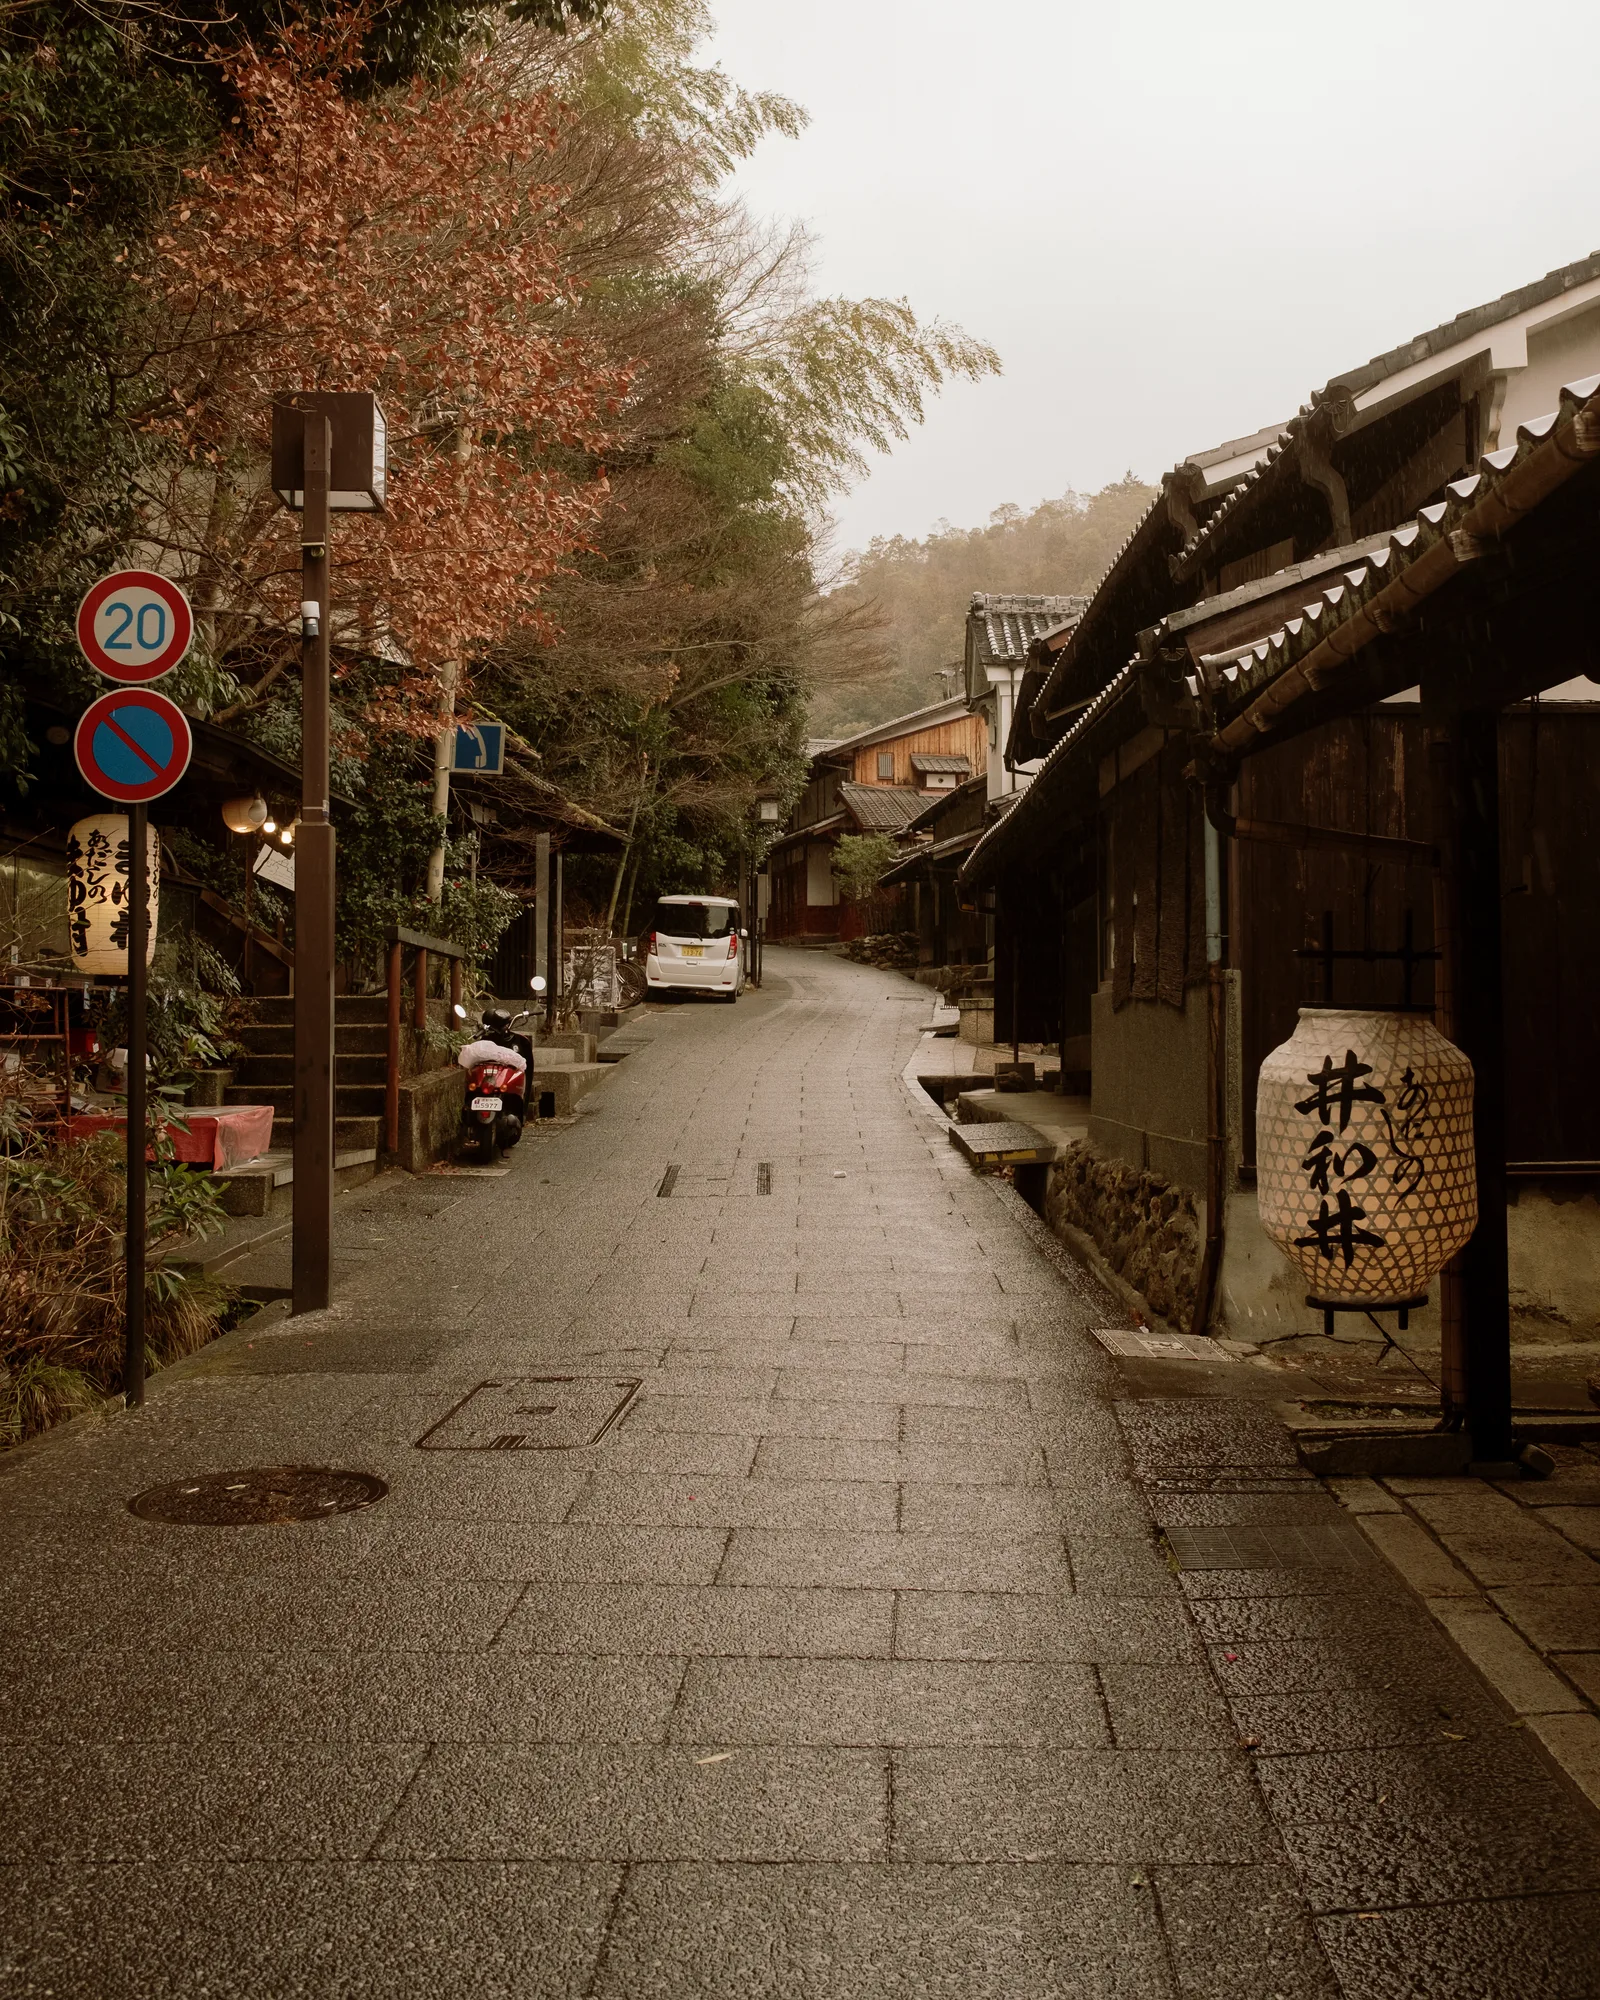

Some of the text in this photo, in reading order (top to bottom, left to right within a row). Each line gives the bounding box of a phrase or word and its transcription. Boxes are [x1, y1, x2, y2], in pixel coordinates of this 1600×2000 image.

[104, 602, 166, 650] 20
[85, 829, 112, 904] あだしの
[1294, 1049, 1386, 1270] 井和井
[1380, 1066, 1429, 1208] あだしの
